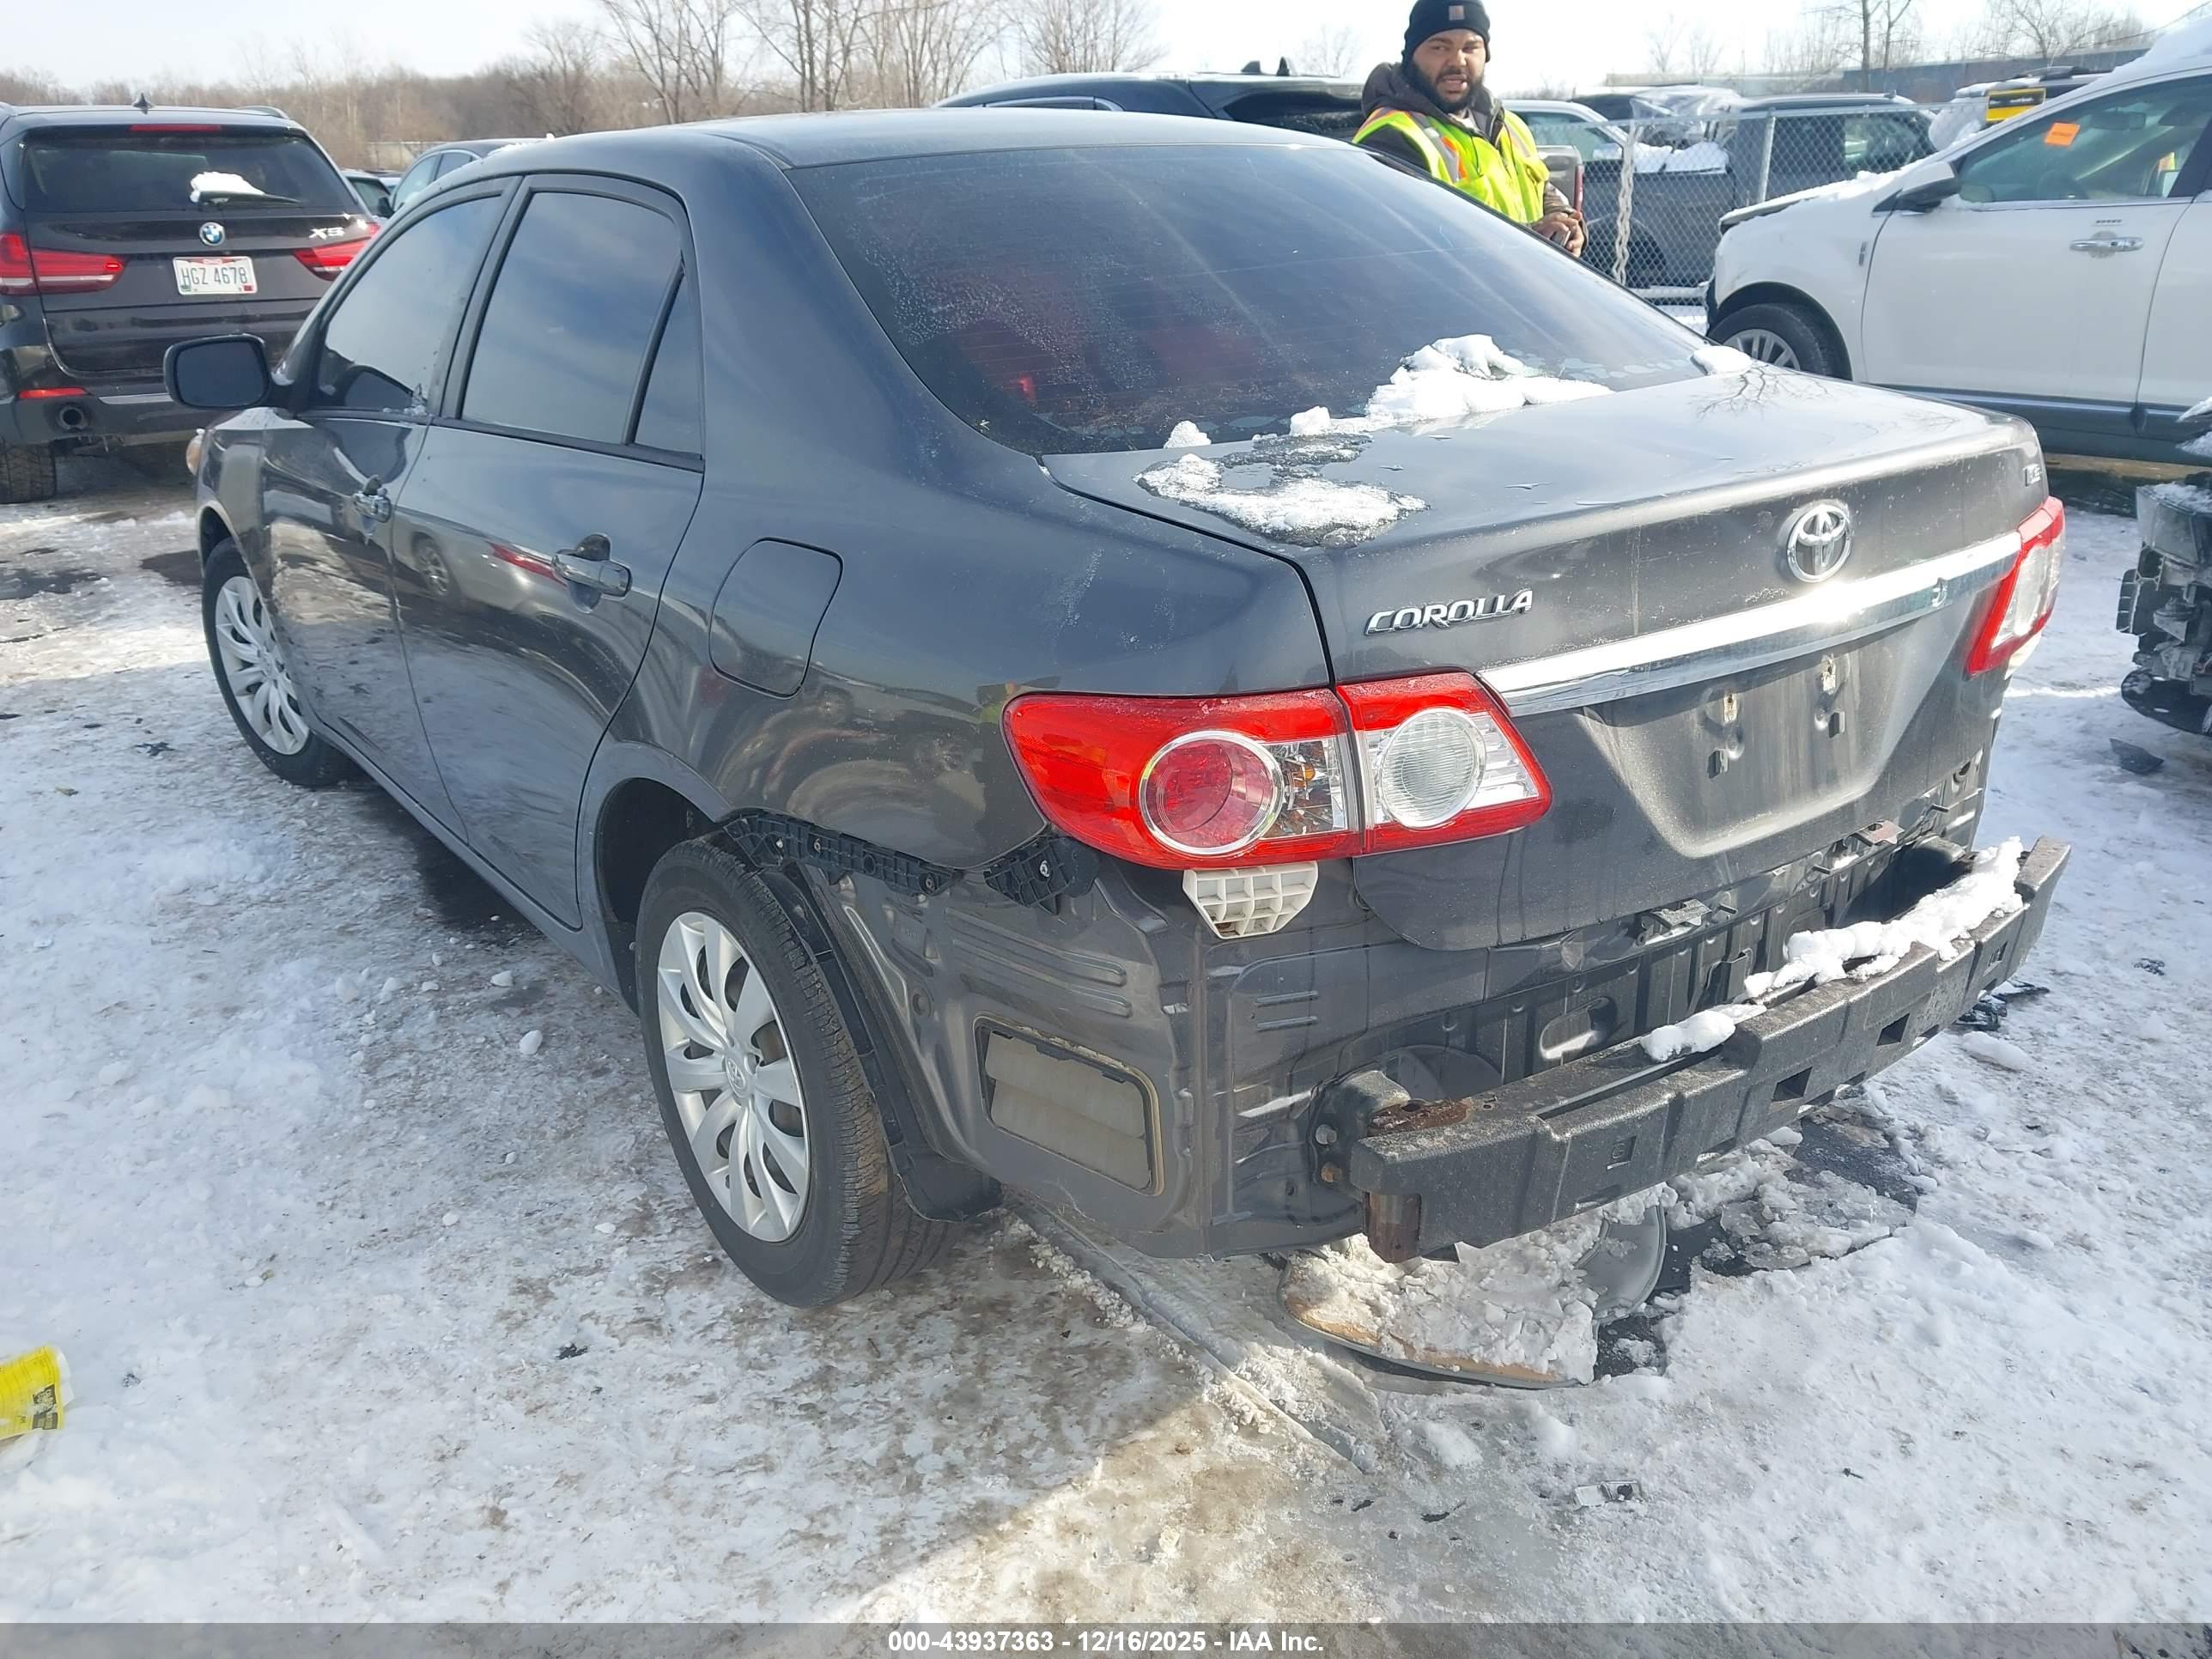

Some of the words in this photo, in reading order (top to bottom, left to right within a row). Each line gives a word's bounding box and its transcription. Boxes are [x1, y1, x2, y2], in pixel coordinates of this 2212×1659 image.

[181, 267, 209, 285] HGZ
[214, 267, 247, 285] 4678
[1364, 588, 1533, 635] COROLLA
